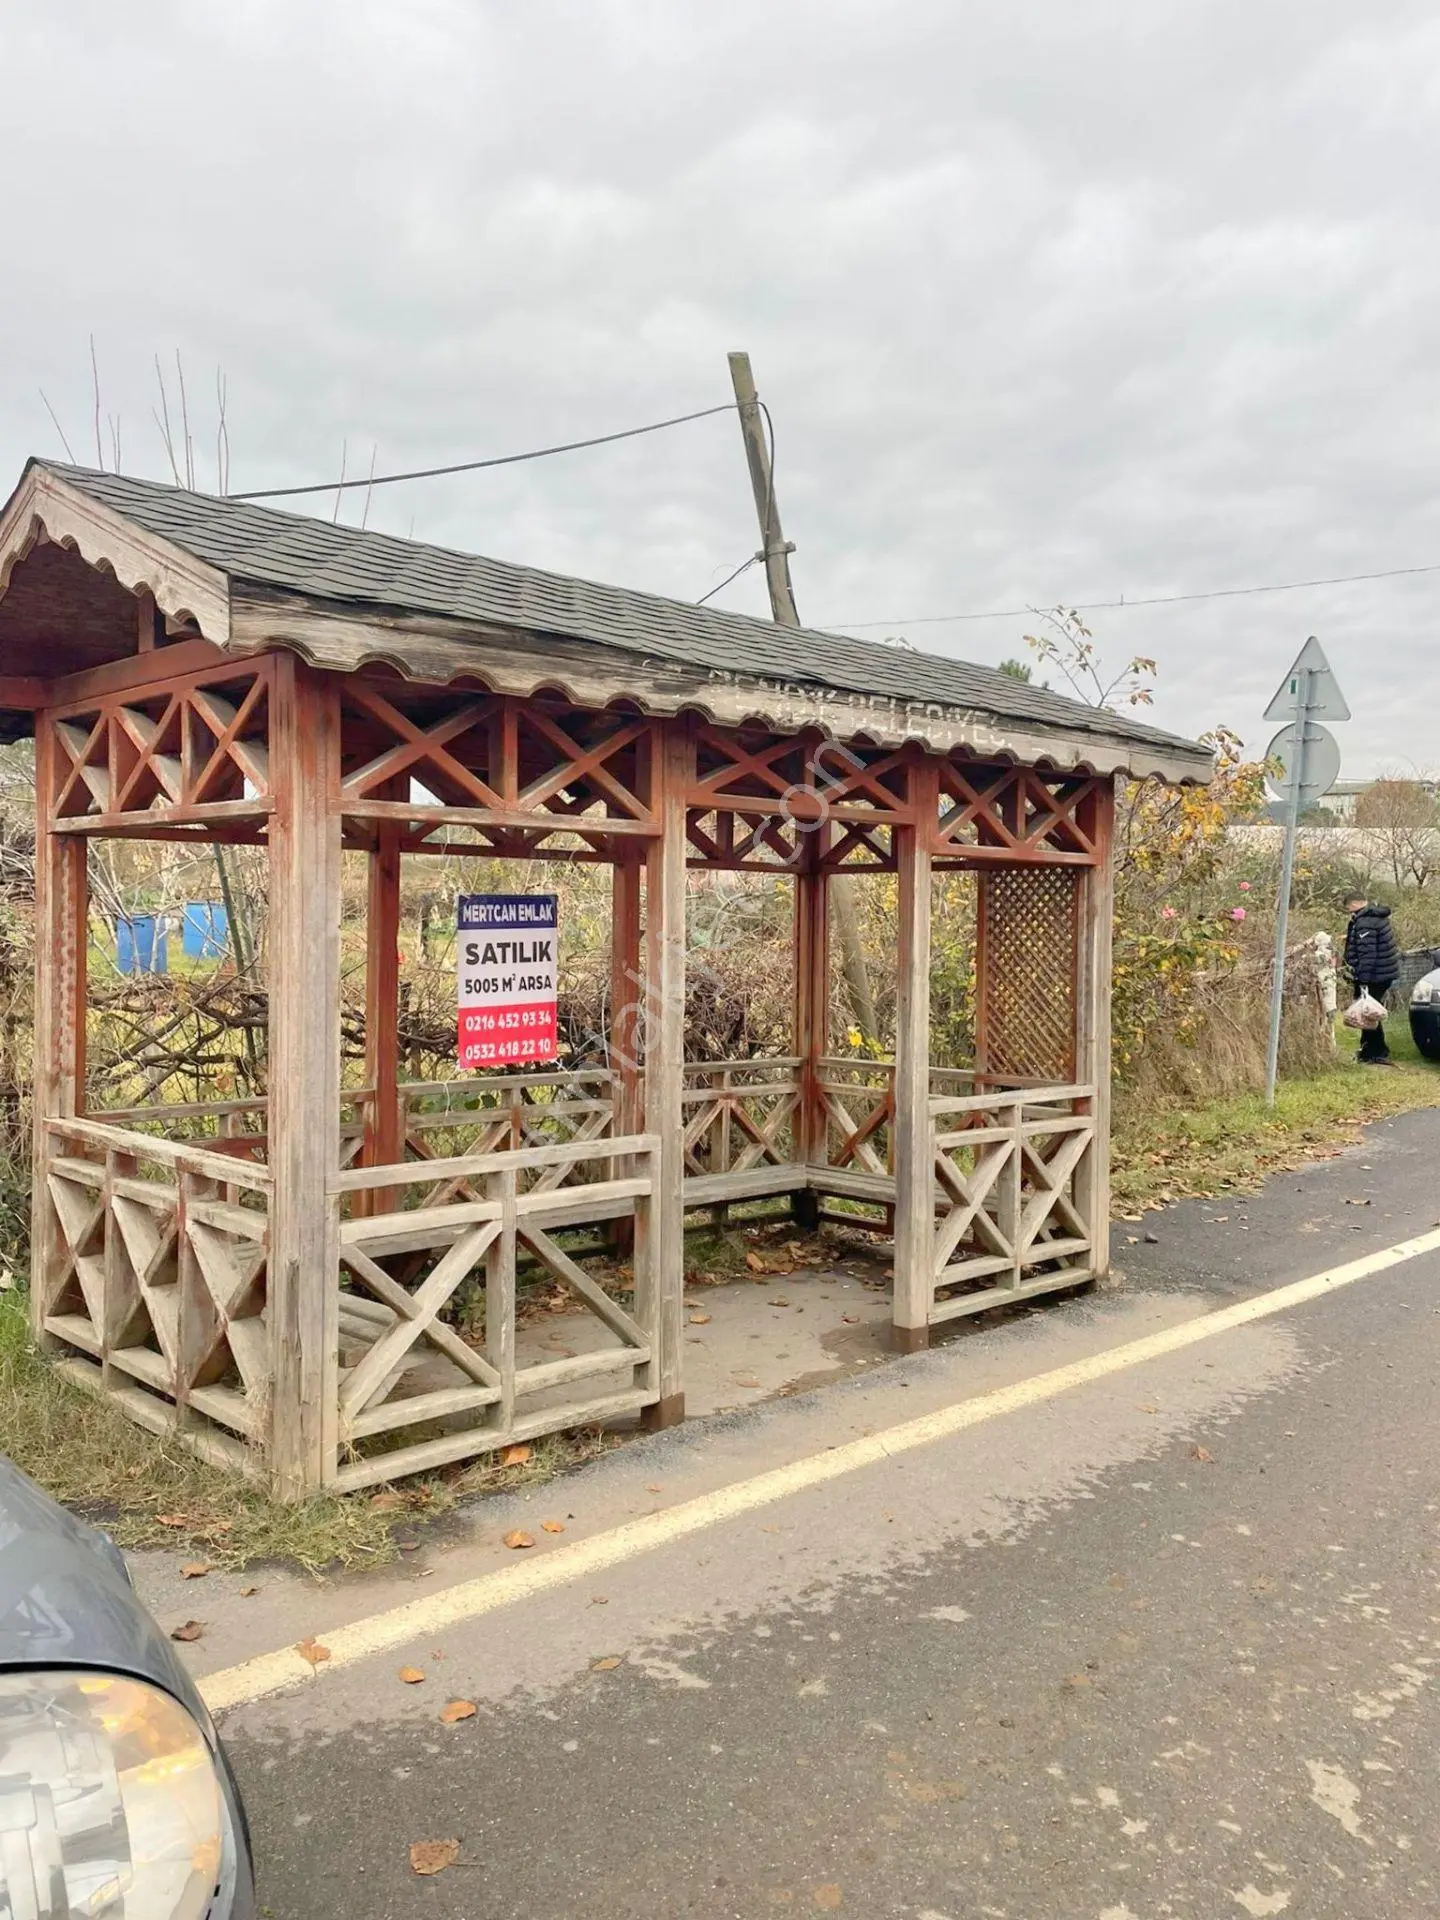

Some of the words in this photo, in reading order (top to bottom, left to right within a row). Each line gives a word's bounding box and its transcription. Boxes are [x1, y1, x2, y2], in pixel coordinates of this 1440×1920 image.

[463, 905, 516, 922] MERTCAN
[519, 904, 553, 921] EMLAK
[465, 941, 552, 965] SATILIK
[465, 978, 499, 994] 5005
[518, 975, 552, 991] ARSA
[465, 1015, 495, 1031] 0216
[498, 1014, 520, 1029] 452
[522, 1013, 536, 1026] 93
[538, 1012, 552, 1025] 34
[465, 1044, 496, 1060] 0532
[498, 1042, 520, 1058] 418
[521, 1040, 536, 1055] 22
[538, 1038, 550, 1053] 10
